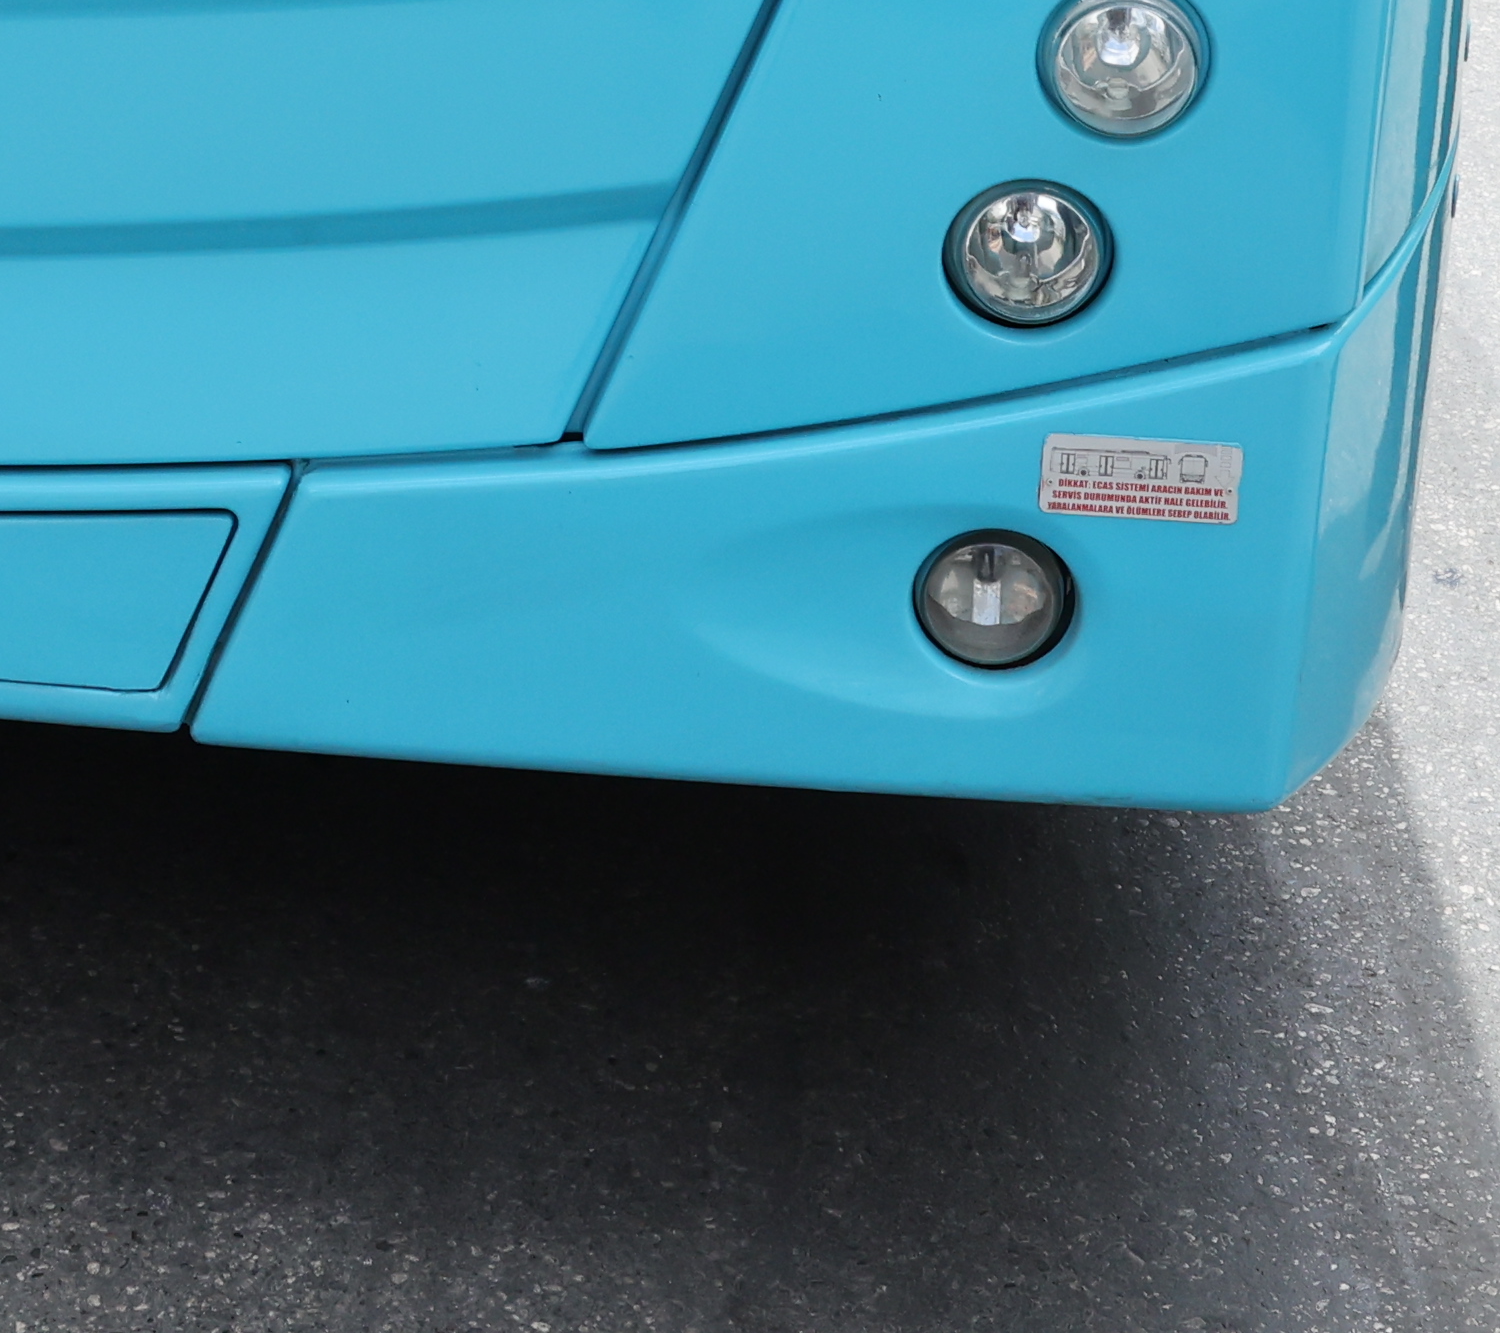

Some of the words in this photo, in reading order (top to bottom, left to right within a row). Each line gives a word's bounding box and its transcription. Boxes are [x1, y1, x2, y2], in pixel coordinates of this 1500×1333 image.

[1058, 476, 1091, 489] DİKKAT:
[1115, 481, 1149, 493] SİSTEMİ
[1151, 484, 1183, 495] ARACIN
[1184, 486, 1213, 497] BAKIM
[1213, 488, 1224, 498] VE
[1051, 489, 1082, 501] SERVİS
[1083, 492, 1137, 504] DURUMUNDA
[1138, 493, 1162, 506] AKTİF
[1047, 501, 1114, 514] YARALANMALARA
[1115, 505, 1126, 515] VE
[1126, 505, 1166, 518] ÖLÜMLERE
[1167, 508, 1192, 519] SEBEP
